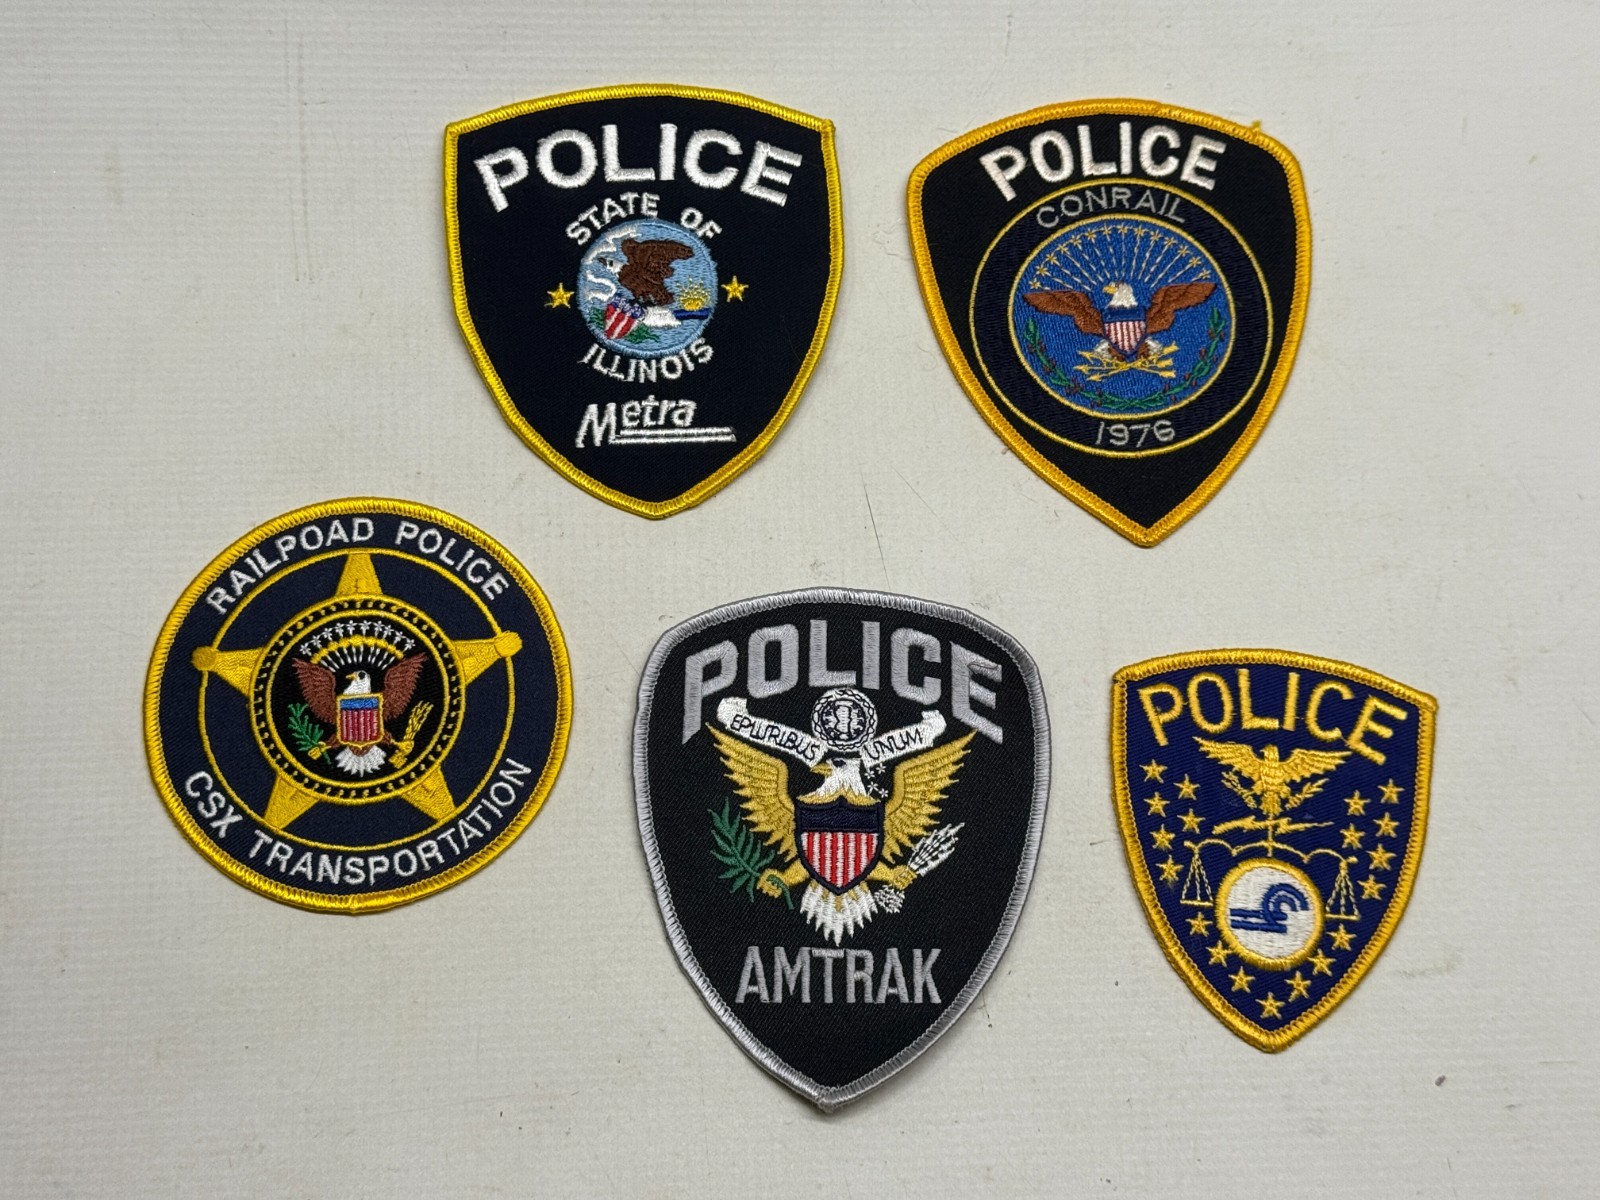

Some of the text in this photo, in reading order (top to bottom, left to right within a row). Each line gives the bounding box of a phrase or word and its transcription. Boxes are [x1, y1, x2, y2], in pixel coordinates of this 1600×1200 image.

[474, 123, 802, 212] POLICE
[979, 121, 1226, 201] POLICE
[565, 192, 722, 246] STATE OF
[1036, 186, 1186, 229] CONRAIL
[580, 338, 714, 384] ILLINOIS
[575, 395, 698, 448] Metra
[1095, 420, 1176, 447] 1976
[395, 521, 510, 601] POLICE
[682, 619, 1003, 745] POLICE
[863, 728, 924, 760] UNUM
[1137, 668, 1408, 765] POLICE
[185, 758, 532, 886] CSX TRANSPORTATION
[735, 946, 942, 1004] AMTRAK
